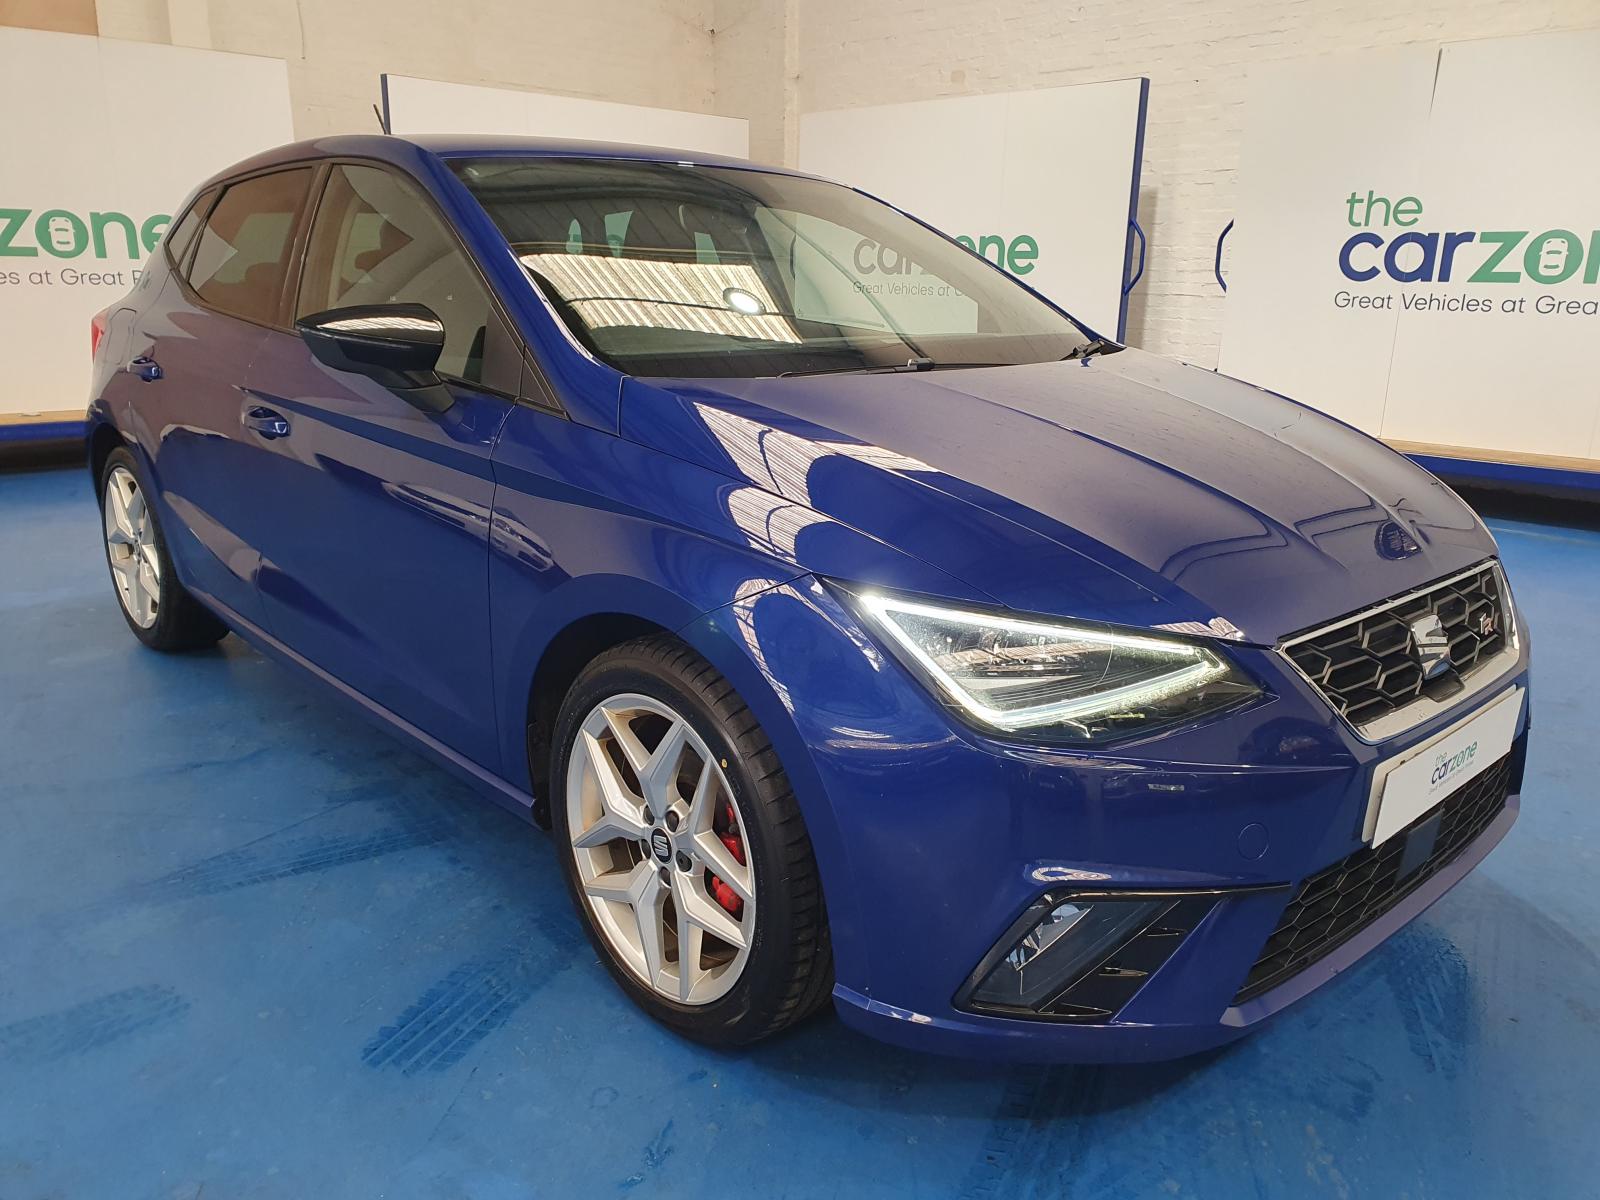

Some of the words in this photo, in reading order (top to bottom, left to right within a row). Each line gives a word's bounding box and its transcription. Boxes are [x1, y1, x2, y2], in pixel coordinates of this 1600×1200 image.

[1346, 190, 1423, 227] the
[28, 270, 53, 286] at
[60, 268, 125, 286] Great
[853, 280, 884, 296] Great
[888, 281, 935, 297] Vehicles
[937, 285, 951, 297] at
[1334, 290, 1393, 310] Great
[1401, 292, 1493, 312] Vehicles
[1501, 297, 1527, 314] at
[1431, 741, 1478, 785] carzone
